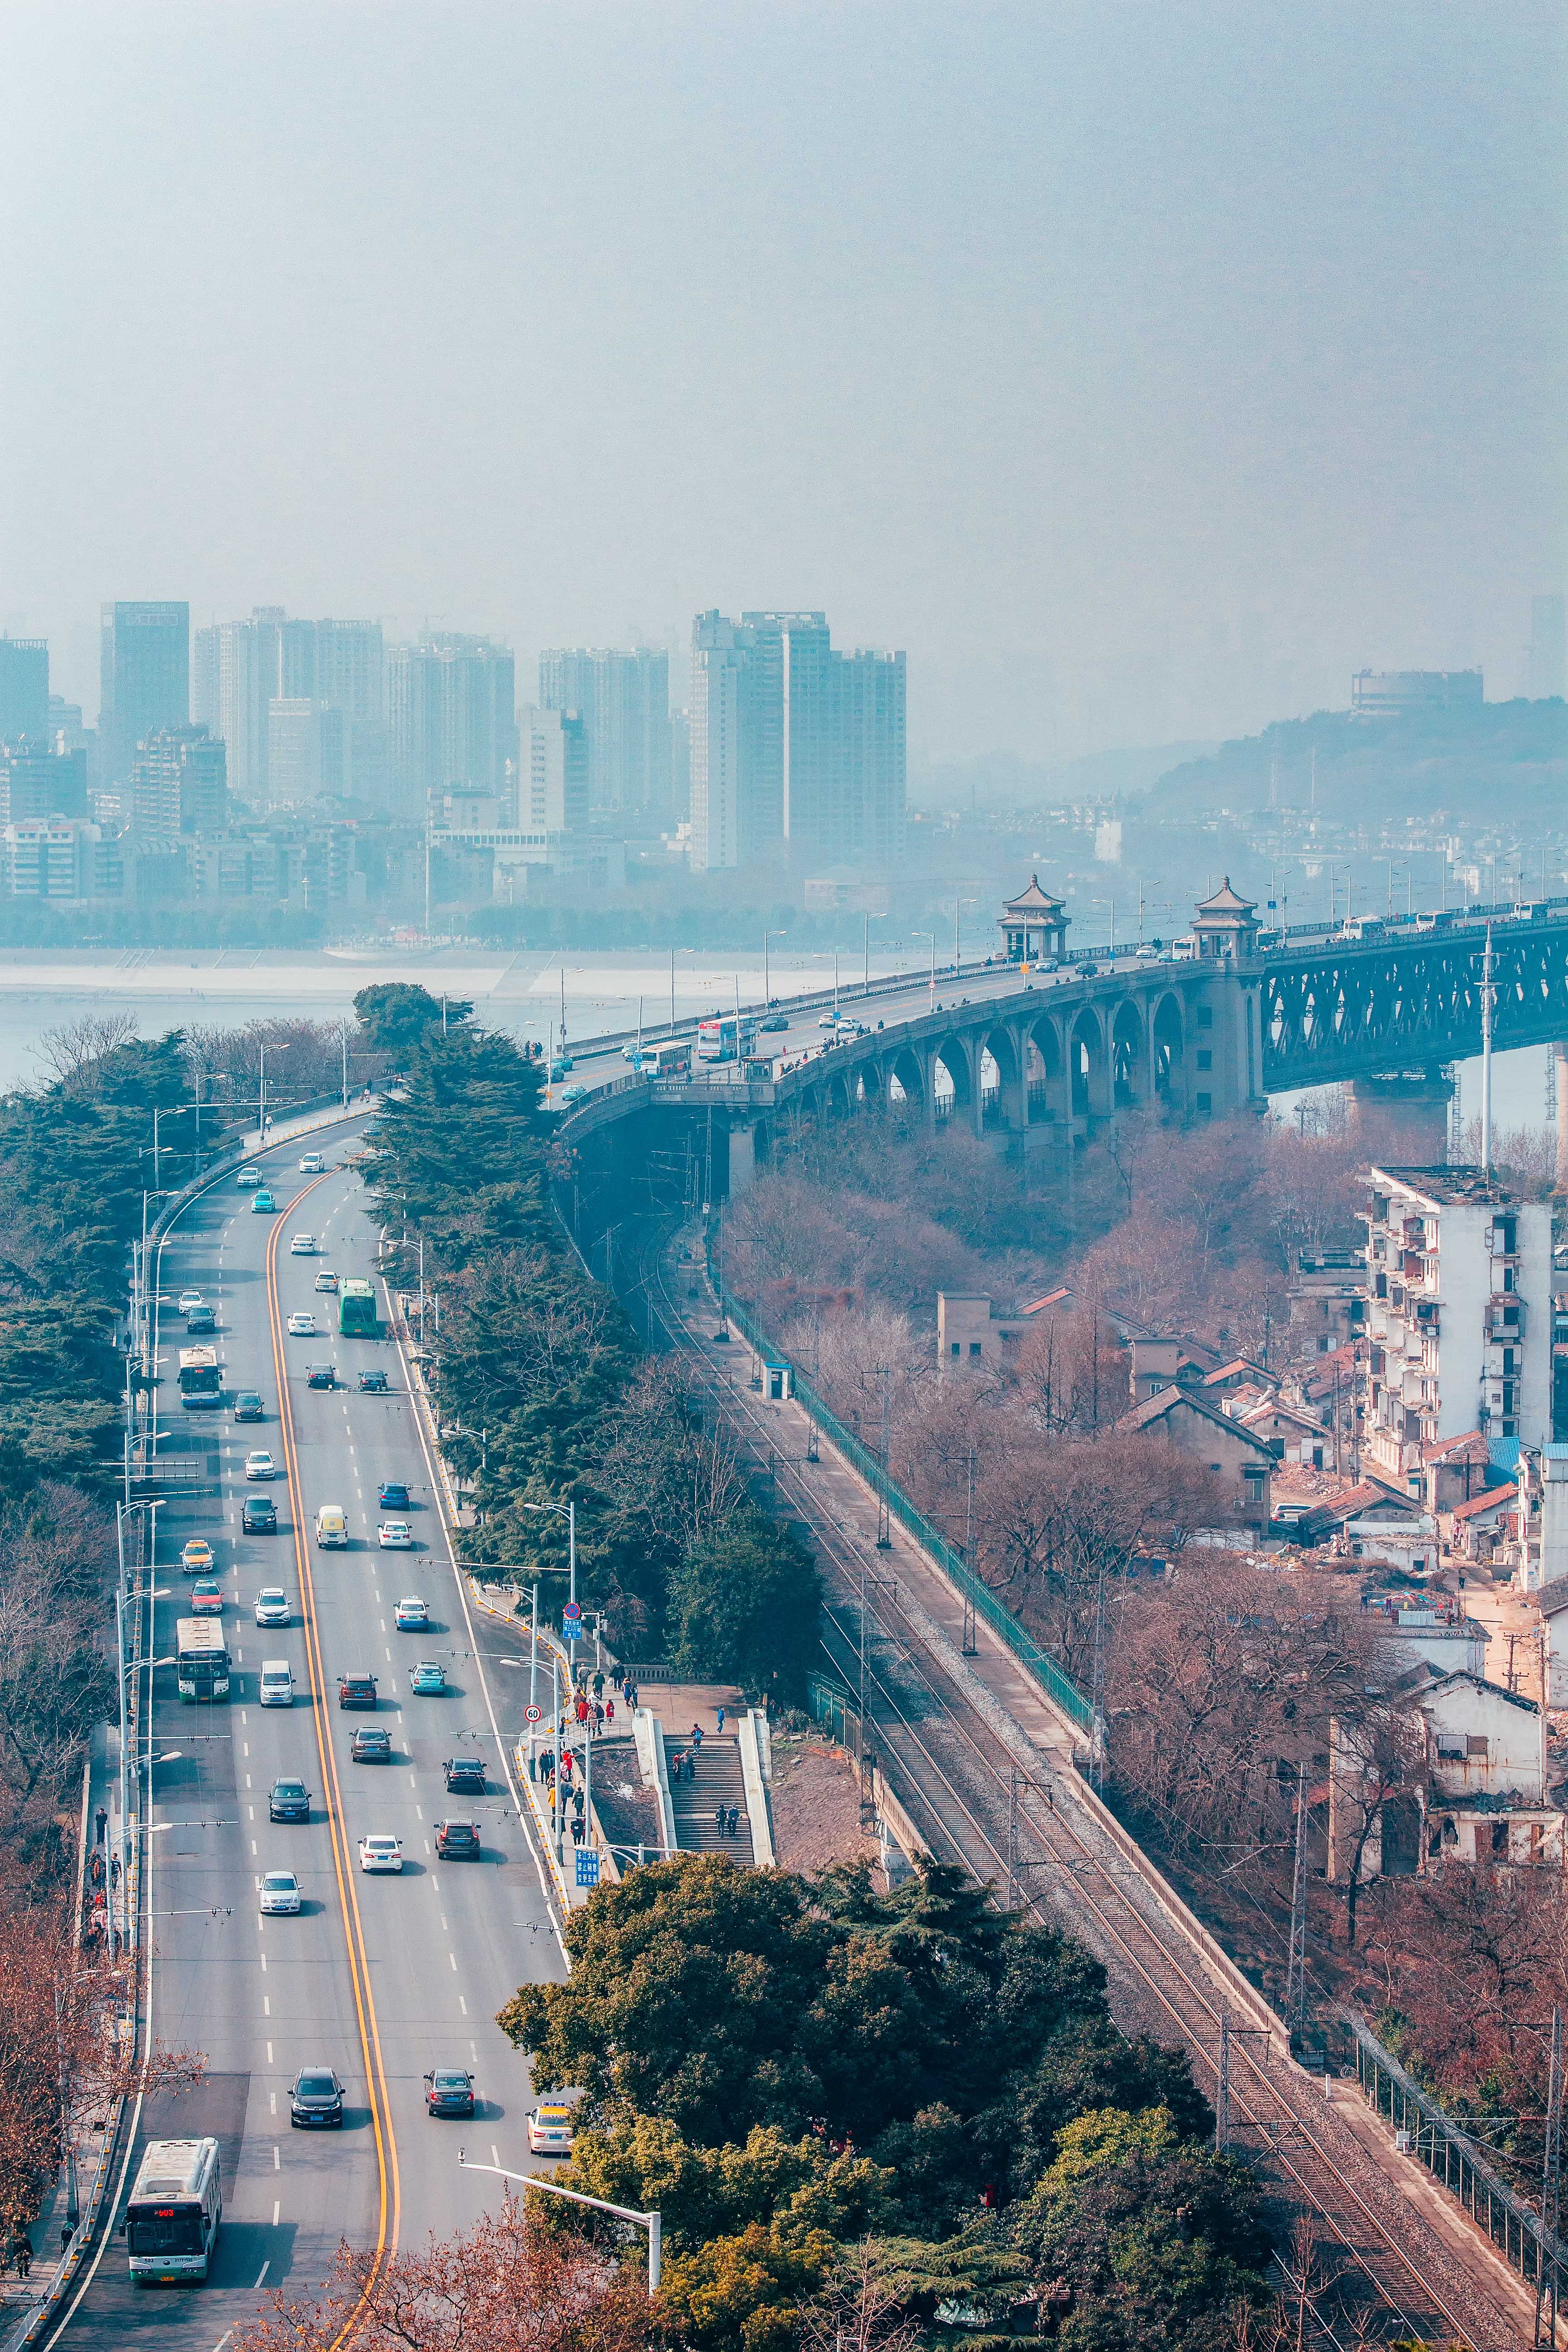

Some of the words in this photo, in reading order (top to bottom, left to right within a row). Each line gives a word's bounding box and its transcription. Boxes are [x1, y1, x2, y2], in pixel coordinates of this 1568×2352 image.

[528, 1710, 538, 1718] 60
[578, 1851, 597, 1861] 长江大桥
[578, 1862, 597, 1872] 禁止随意
[578, 1873, 598, 1884] 变更车道
